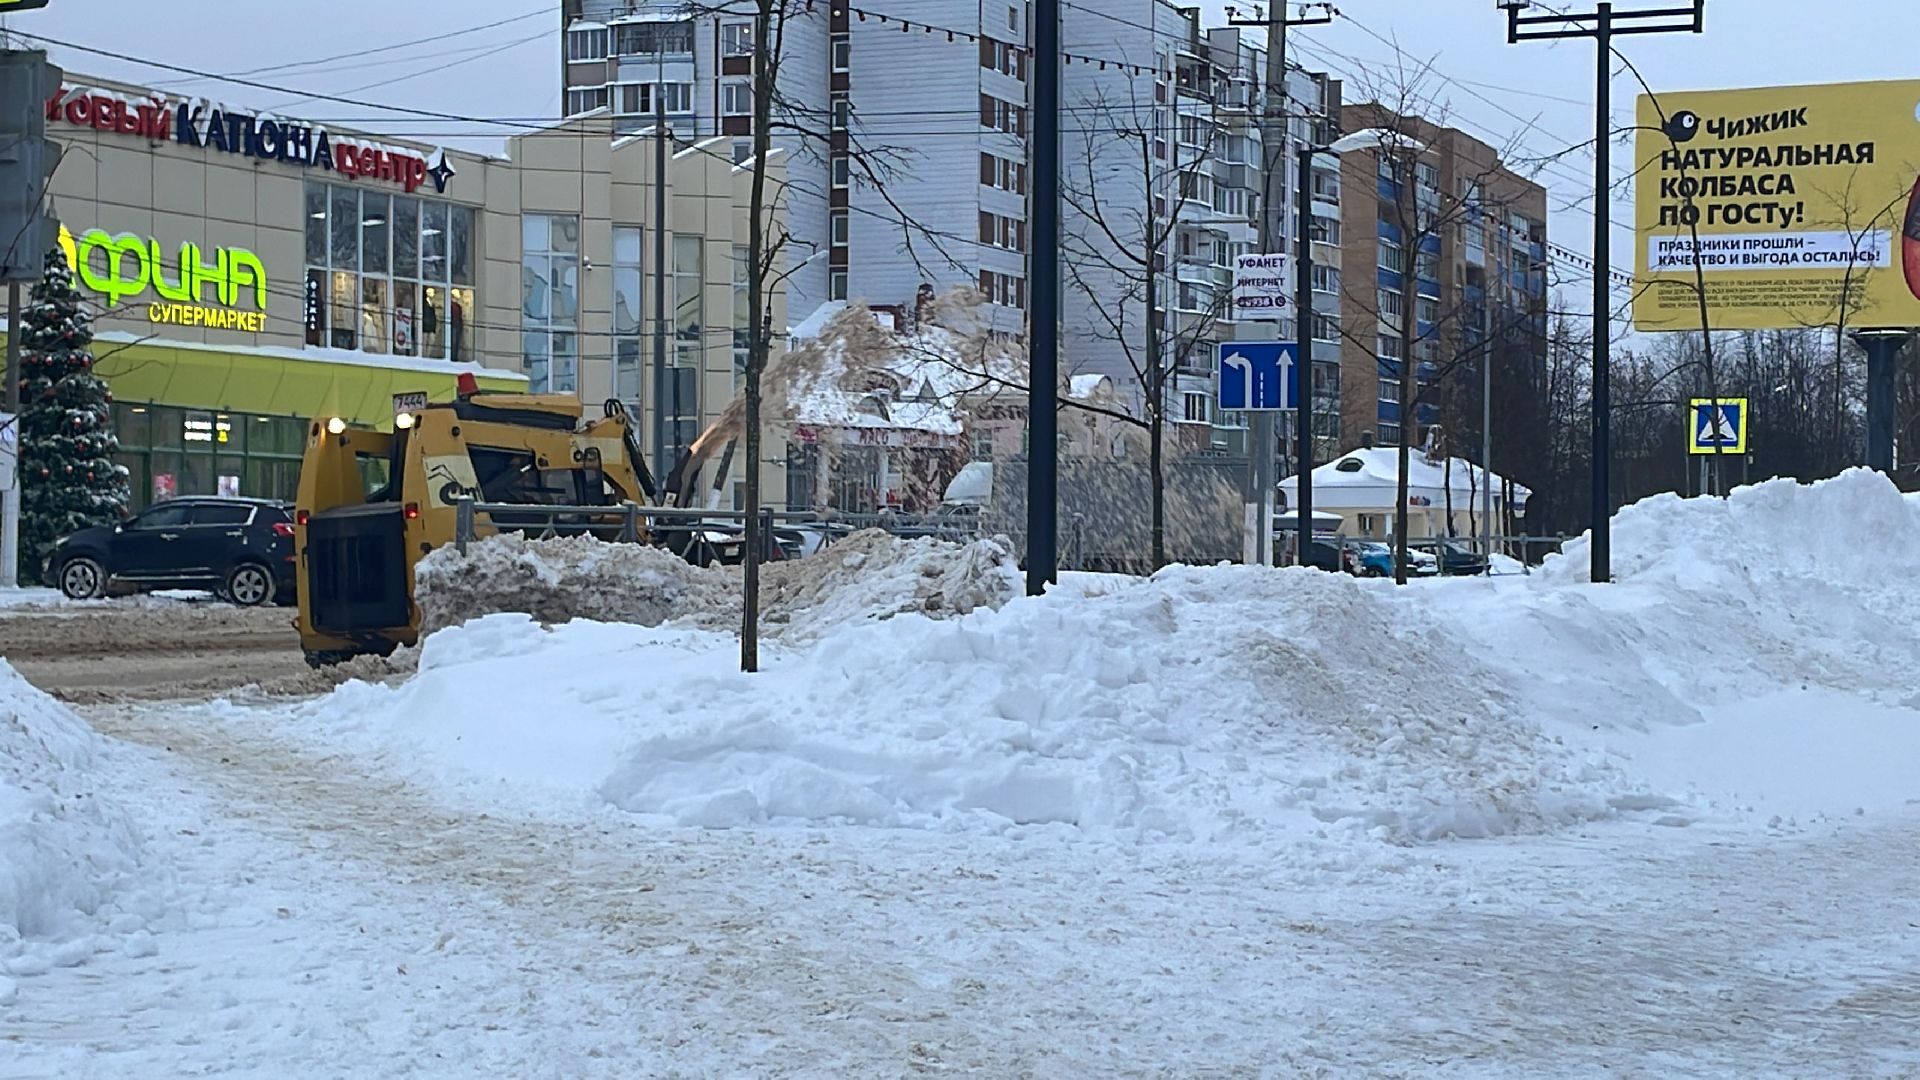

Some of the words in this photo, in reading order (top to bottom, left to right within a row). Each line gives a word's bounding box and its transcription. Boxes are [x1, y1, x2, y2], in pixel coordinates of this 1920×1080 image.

[177, 103, 334, 170] КАТЮША
[1661, 142, 1875, 171] НАТУРАЛЬНАЯ
[1660, 174, 1795, 198] КОЛБАСА
[1659, 204, 1700, 226] ПО
[1658, 239, 1741, 252] ПРАЗДНИКИ
[1743, 238, 1804, 250] ПРОШЛИ
[1238, 258, 1285, 268] УФАНЕТ
[1658, 253, 1726, 266] КАЧЕСТВО
[1729, 254, 1739, 264] И
[1742, 252, 1799, 265] ВЫГОДА
[1802, 251, 1880, 263] ОСТАЛИСЬ!
[1237, 277, 1285, 287] ИНТЕРНЕТ
[149, 302, 267, 332] СУПЕРМАРКЕТ
